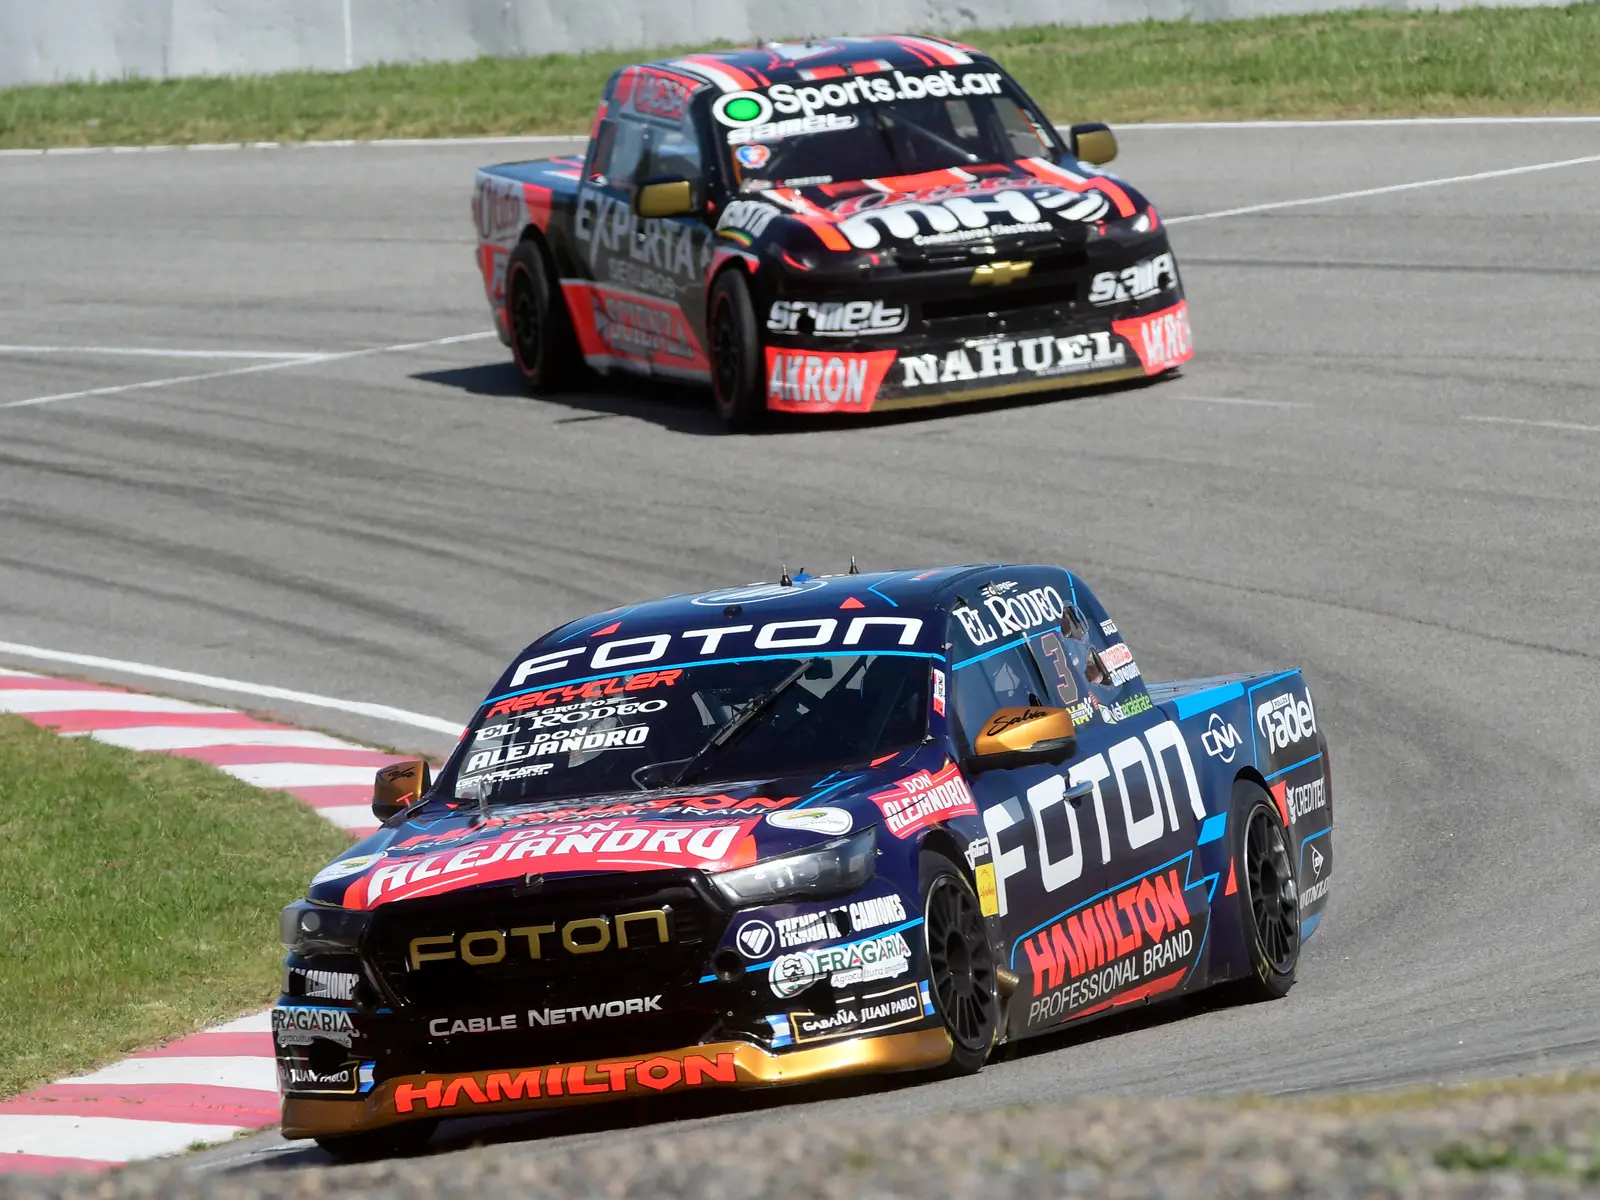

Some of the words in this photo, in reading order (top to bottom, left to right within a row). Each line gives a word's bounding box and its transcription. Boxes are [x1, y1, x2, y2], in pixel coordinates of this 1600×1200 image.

[768, 70, 1002, 116] Sports.bet.ar
[769, 354, 868, 404] AKRON
[898, 331, 1126, 388] NAHUEL
[952, 605, 998, 646] EL
[983, 586, 1063, 637] RODEO
[509, 616, 923, 687] FOTON
[1040, 632, 1079, 704] 3
[474, 722, 525, 742] EL
[529, 700, 668, 731] RODEO
[533, 727, 588, 744] DON
[987, 709, 1048, 737] Salva
[1256, 686, 1317, 754] Fadel
[465, 726, 650, 773] ALEJANDRO
[882, 775, 971, 832] ALEJANDRO
[902, 773, 932, 794] DON
[510, 819, 612, 842] DON
[983, 720, 1207, 917] FOTON
[366, 825, 741, 907] ALEJANDRO
[849, 893, 907, 932] CAMIONES
[1023, 868, 1190, 996] HAMILTON
[409, 908, 670, 972] FOTON
[816, 936, 910, 972] FRAGARIA
[1028, 953, 1141, 1027] PROFESSIONAL
[1143, 928, 1194, 978] BRAND
[429, 1016, 518, 1038] CABLE
[528, 995, 663, 1027] NETWORK
[860, 1002, 892, 1024] JUAN
[890, 996, 918, 1014] PABLO
[394, 1052, 737, 1114] HAMILTON
